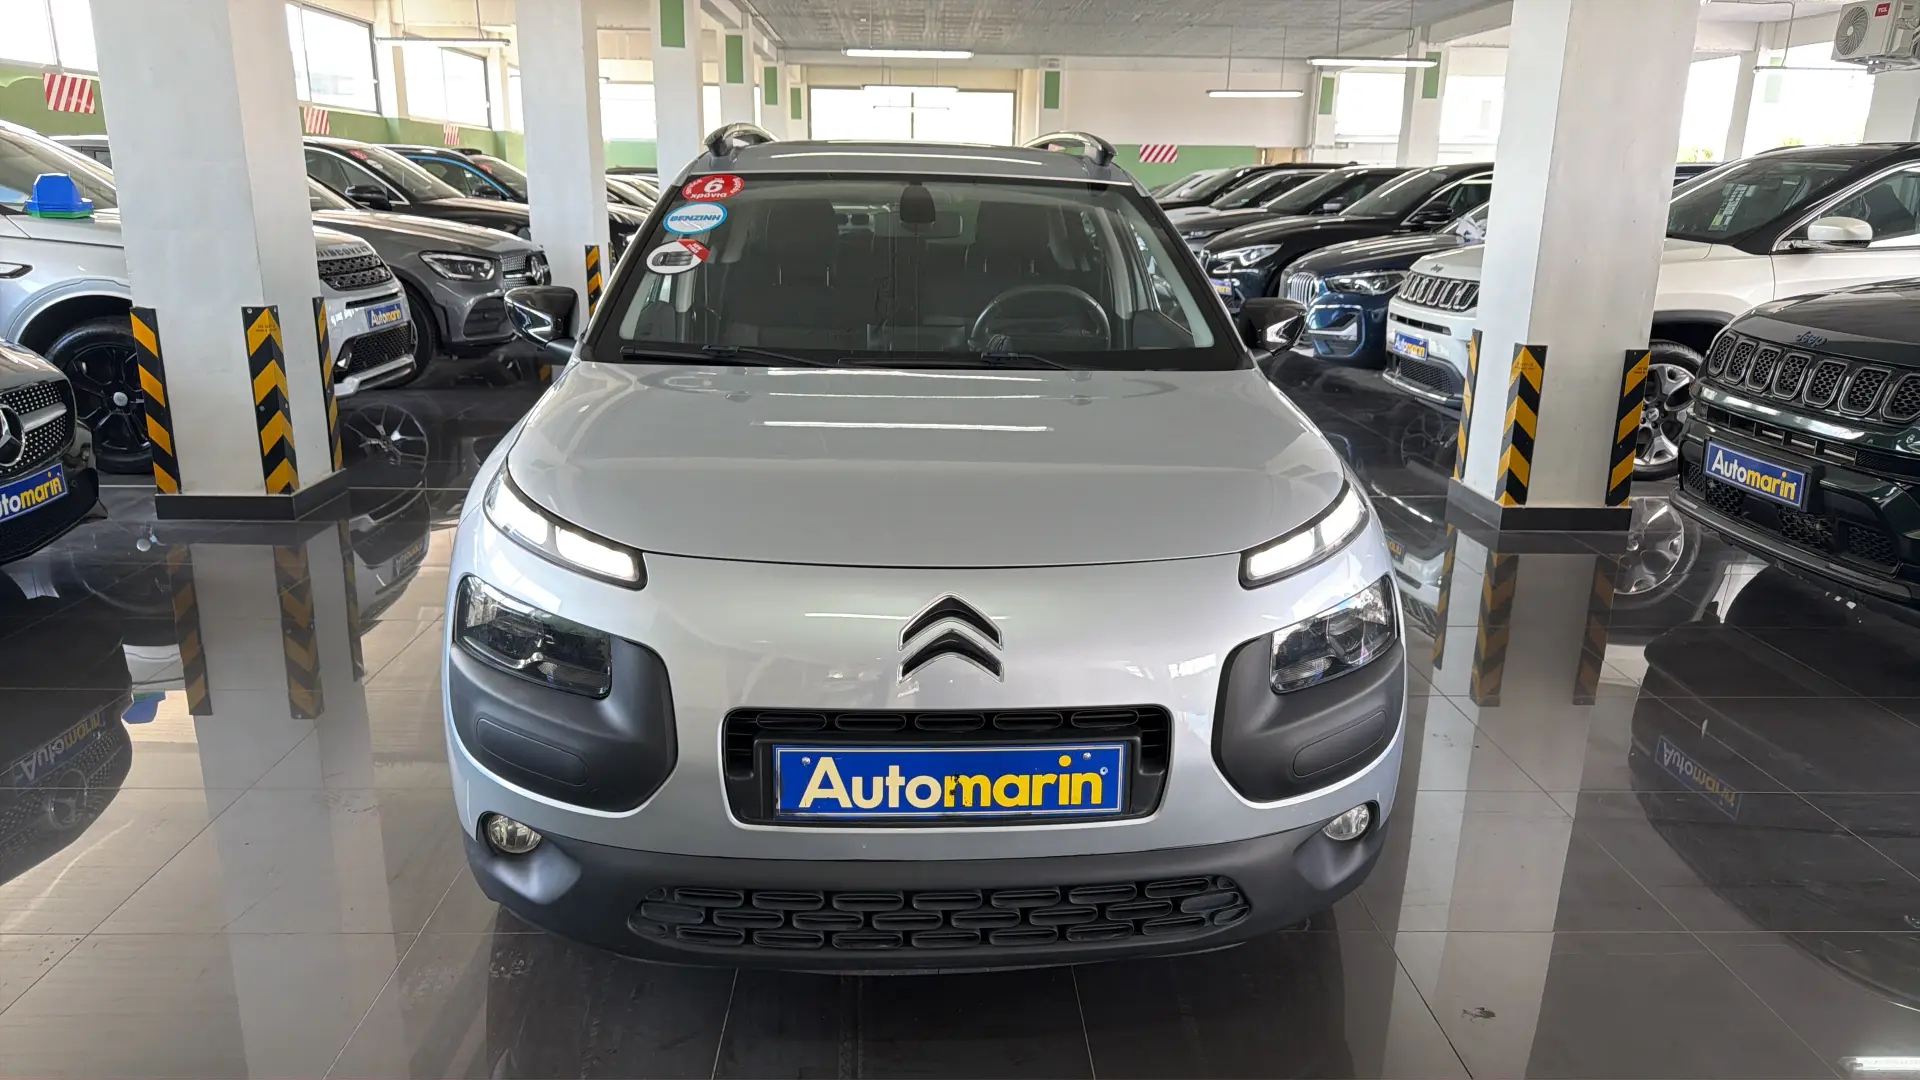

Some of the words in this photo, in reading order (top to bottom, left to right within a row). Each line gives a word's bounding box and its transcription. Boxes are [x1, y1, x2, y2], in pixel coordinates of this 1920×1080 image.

[690, 192, 727, 200] χρόνια
[704, 179, 725, 193] 6
[0, 471, 62, 518] tomarin
[1710, 449, 1797, 501] Automarin
[798, 755, 1103, 809] Automarin
